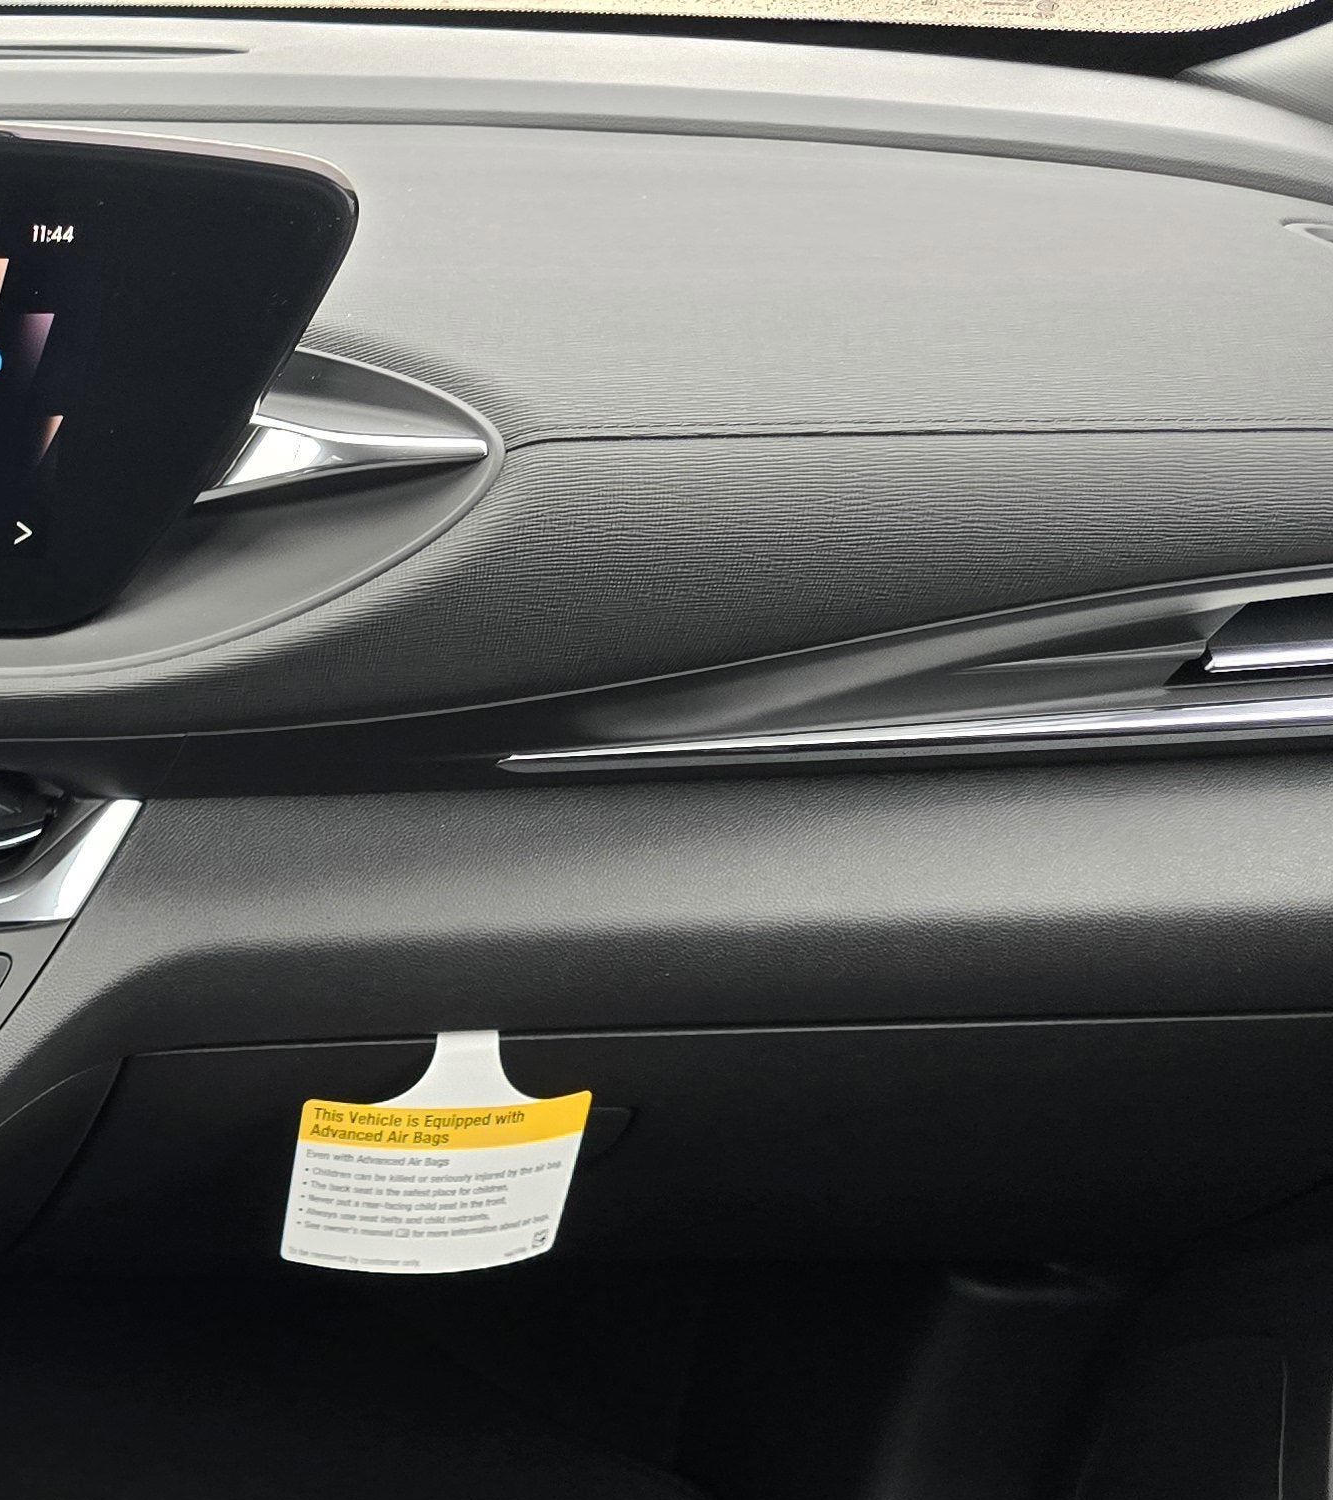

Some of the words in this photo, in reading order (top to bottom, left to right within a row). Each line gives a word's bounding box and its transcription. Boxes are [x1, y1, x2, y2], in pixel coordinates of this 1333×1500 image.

[32, 224, 75, 243] 11:44
[313, 1108, 344, 1122] This
[349, 1111, 402, 1127] Vehicle
[406, 1115, 419, 1128] is
[423, 1113, 492, 1130] Equipped
[495, 1110, 525, 1124] with
[309, 1124, 383, 1142] Advanced
[387, 1131, 408, 1144] Air
[413, 1132, 449, 1146] Bags
